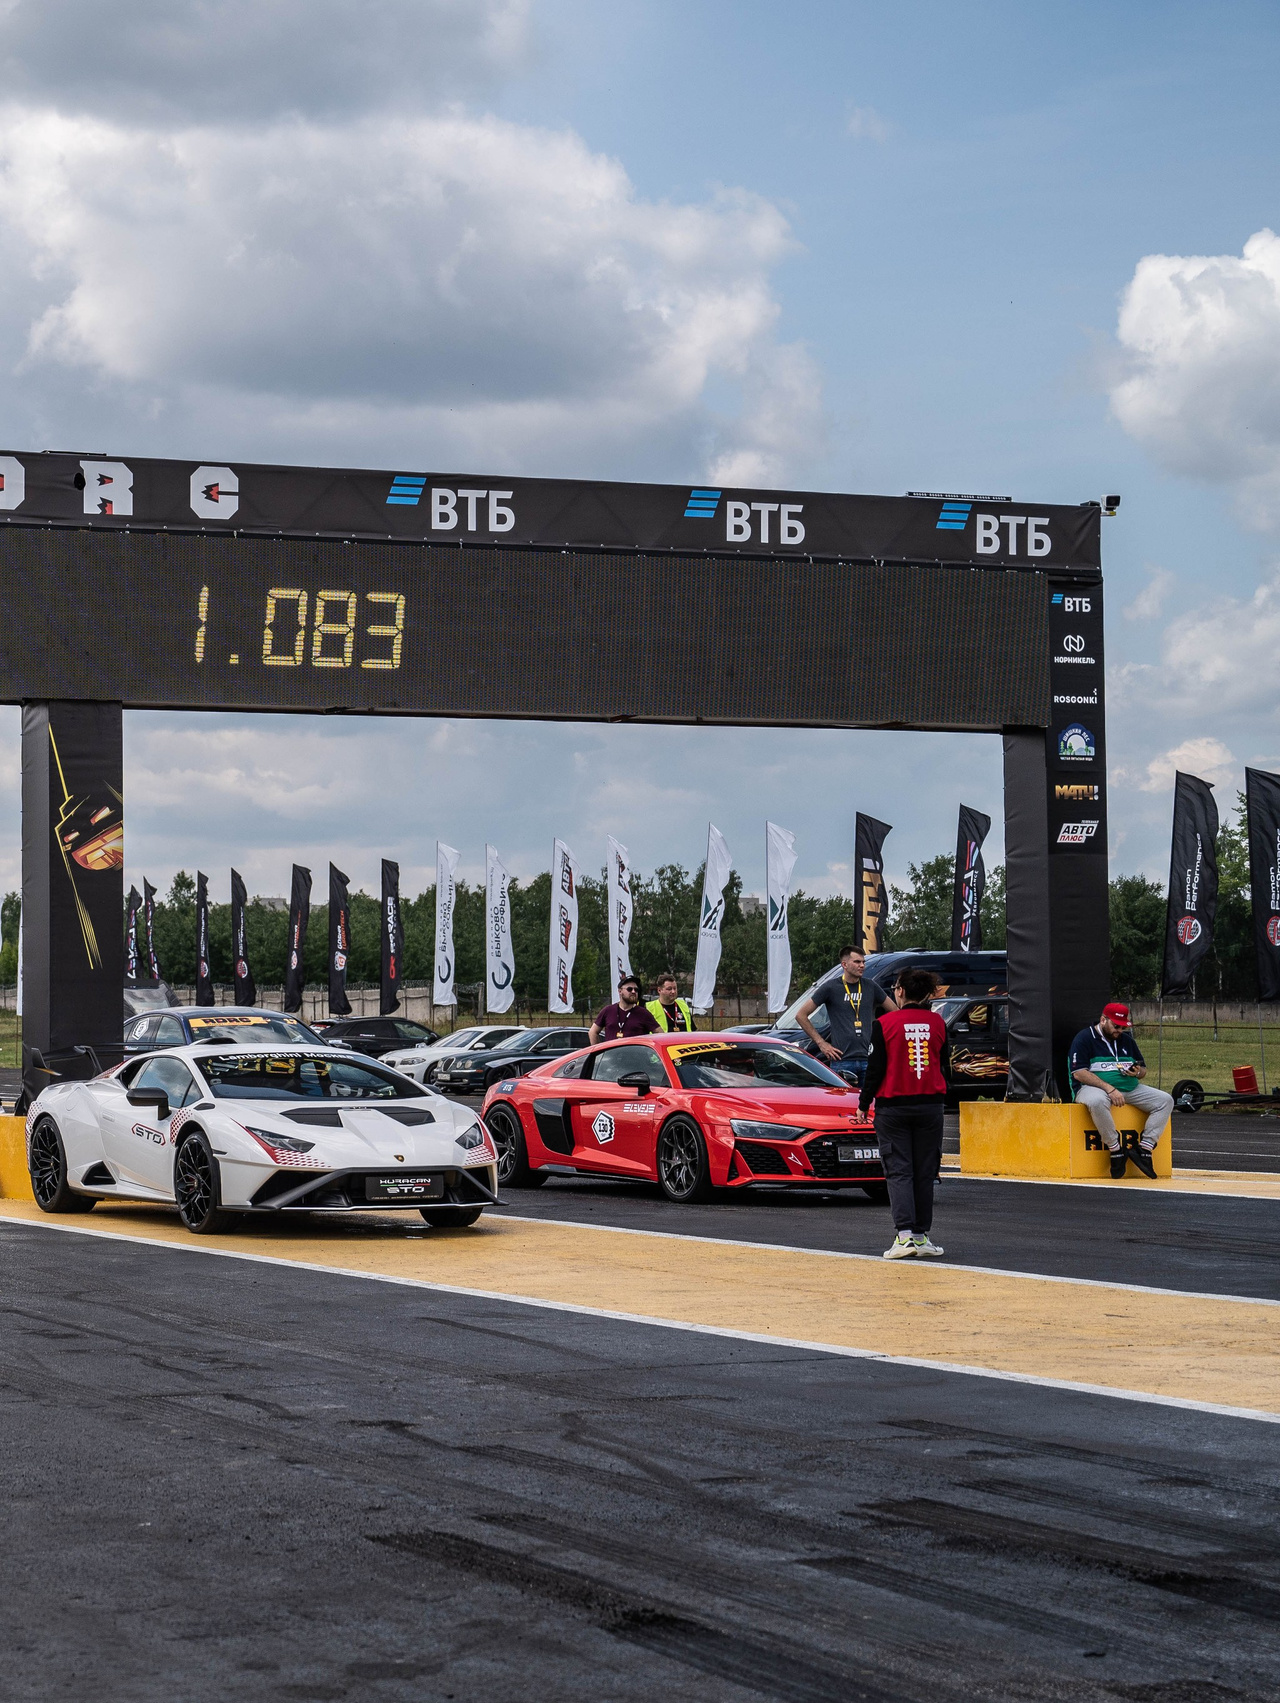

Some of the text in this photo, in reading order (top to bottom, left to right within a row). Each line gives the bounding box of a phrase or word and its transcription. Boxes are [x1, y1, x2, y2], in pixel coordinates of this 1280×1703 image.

[431, 488, 515, 532] ВТБ
[726, 501, 805, 545] ВТБ
[976, 515, 1051, 557] ВТБ
[1064, 597, 1091, 612] ВТБ
[195, 585, 405, 669] 1.083
[1054, 656, 1095, 664] НОРНИКЕЛЬ
[1053, 695, 1098, 704] ROSGONKI
[1055, 785, 1099, 800] МАТЧ!
[1062, 826, 1094, 835] АВТО
[1191, 833, 1202, 911] Performance
[493, 906, 502, 958] БЫКОВО
[219, 1052, 355, 1061] Lamborghini Москва
[676, 1043, 721, 1055] RDRC
[135, 1126, 162, 1144] STO
[598, 1123, 608, 1133] 130
